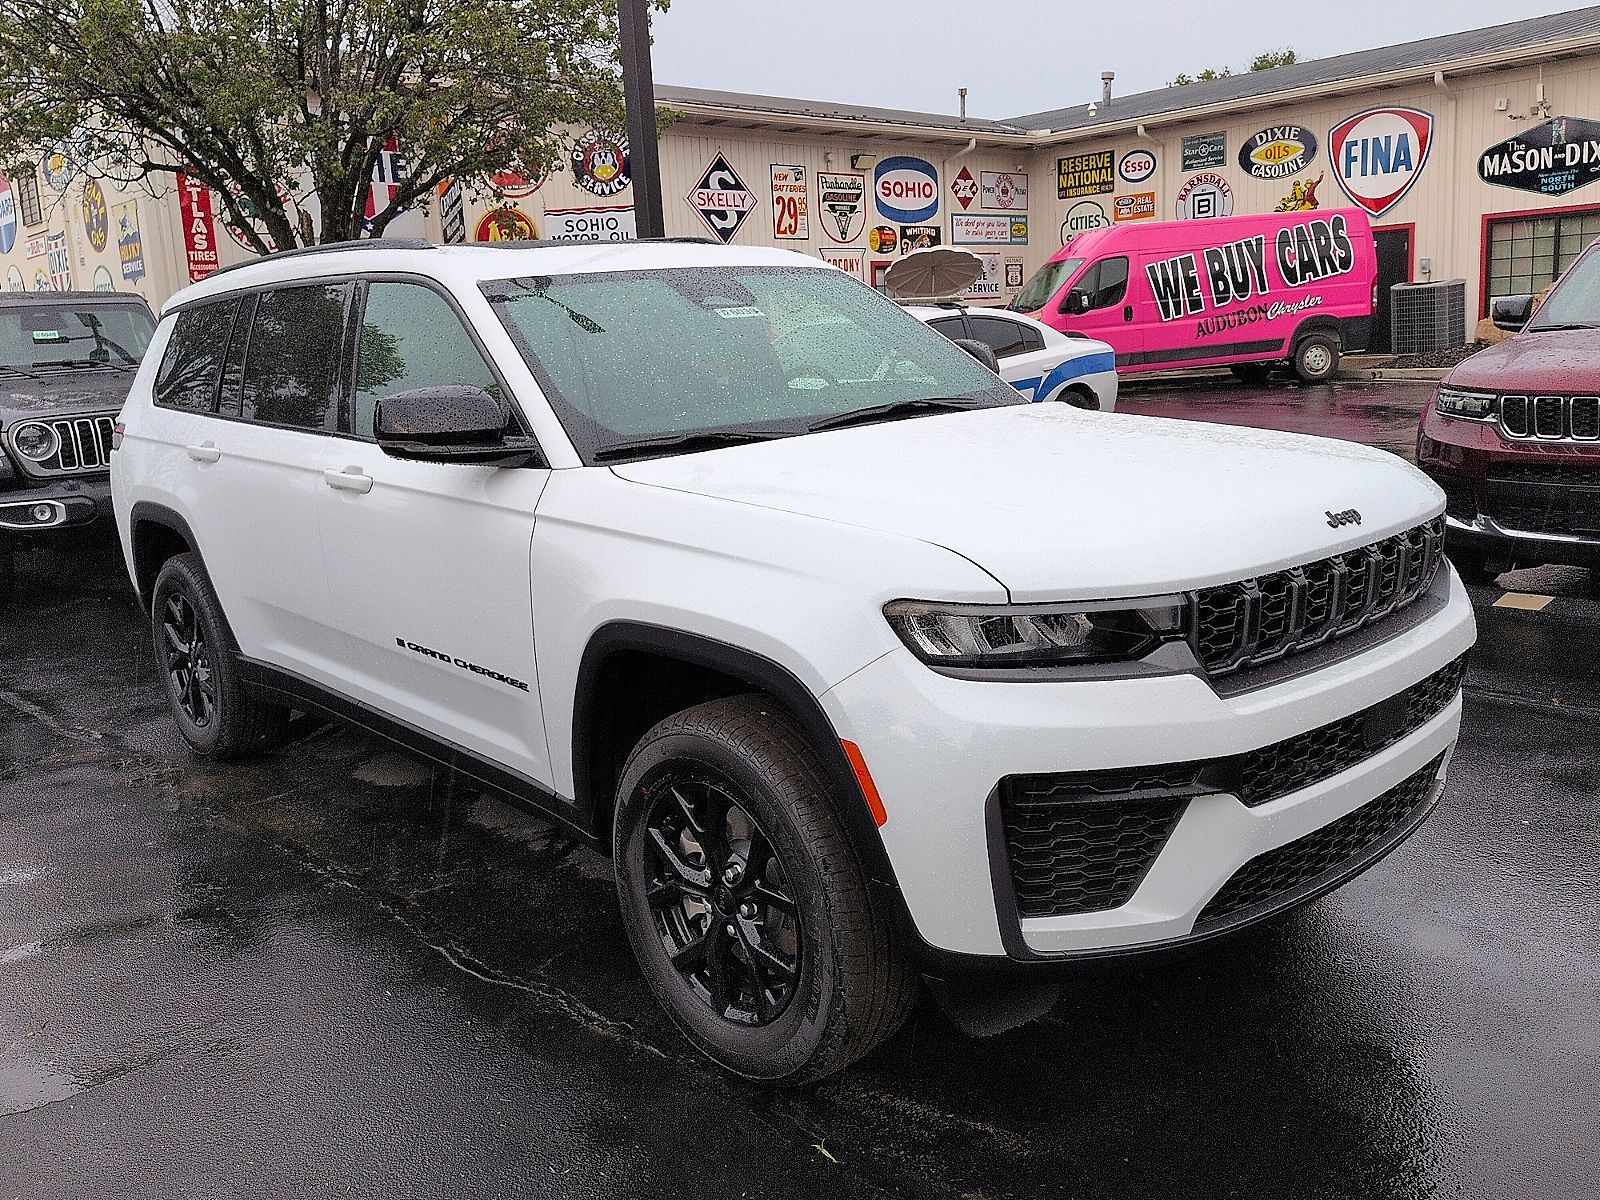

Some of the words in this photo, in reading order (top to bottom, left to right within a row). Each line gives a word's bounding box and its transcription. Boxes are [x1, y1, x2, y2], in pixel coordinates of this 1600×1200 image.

[1254, 126, 1300, 147] DIXIE
[1184, 148, 1199, 156] Star
[1209, 144, 1224, 152] Cars
[1265, 145, 1290, 160] OILS
[1506, 141, 1526, 152] The
[1061, 152, 1111, 174] RESERVE
[1345, 133, 1414, 179] FINA
[1483, 146, 1553, 178] MASON
[1251, 156, 1307, 178] GASOLINE
[579, 172, 631, 195] SERVICE
[773, 173, 789, 182] NEW
[820, 175, 863, 191] Panhandle
[1059, 168, 1114, 189] NATIONAL
[1540, 174, 1575, 185] NORTH
[773, 184, 807, 193] BATTERIES
[880, 180, 934, 200] SOHIO
[1066, 185, 1100, 197] INSURANCE
[1178, 174, 1228, 201] BARNSDALL
[1540, 182, 1575, 192] SOUTH
[697, 191, 748, 208] SKELLY
[825, 193, 858, 202] GASOLINE
[1137, 196, 1153, 205] REAL
[1197, 198, 1211, 214] B
[776, 195, 798, 236] 29
[1133, 204, 1155, 214] ESTATE
[564, 217, 619, 233] SOHIO
[1069, 214, 1101, 231] CITIES
[91, 227, 105, 247] GAS
[48, 248, 70, 275] DIXIE
[187, 250, 217, 261] TIRES
[122, 259, 144, 274] SERVICE
[1145, 253, 1206, 322] WE
[1203, 234, 1270, 307] BUY
[1276, 214, 1355, 287] CARS
[967, 283, 999, 293] SERVICE
[1197, 303, 1271, 339] AUDUBON
[1266, 294, 1323, 320] Chrysler
[1325, 508, 1361, 529] Jeep
[406, 641, 452, 664] GRAND
[453, 658, 530, 693] CHEROKEE
